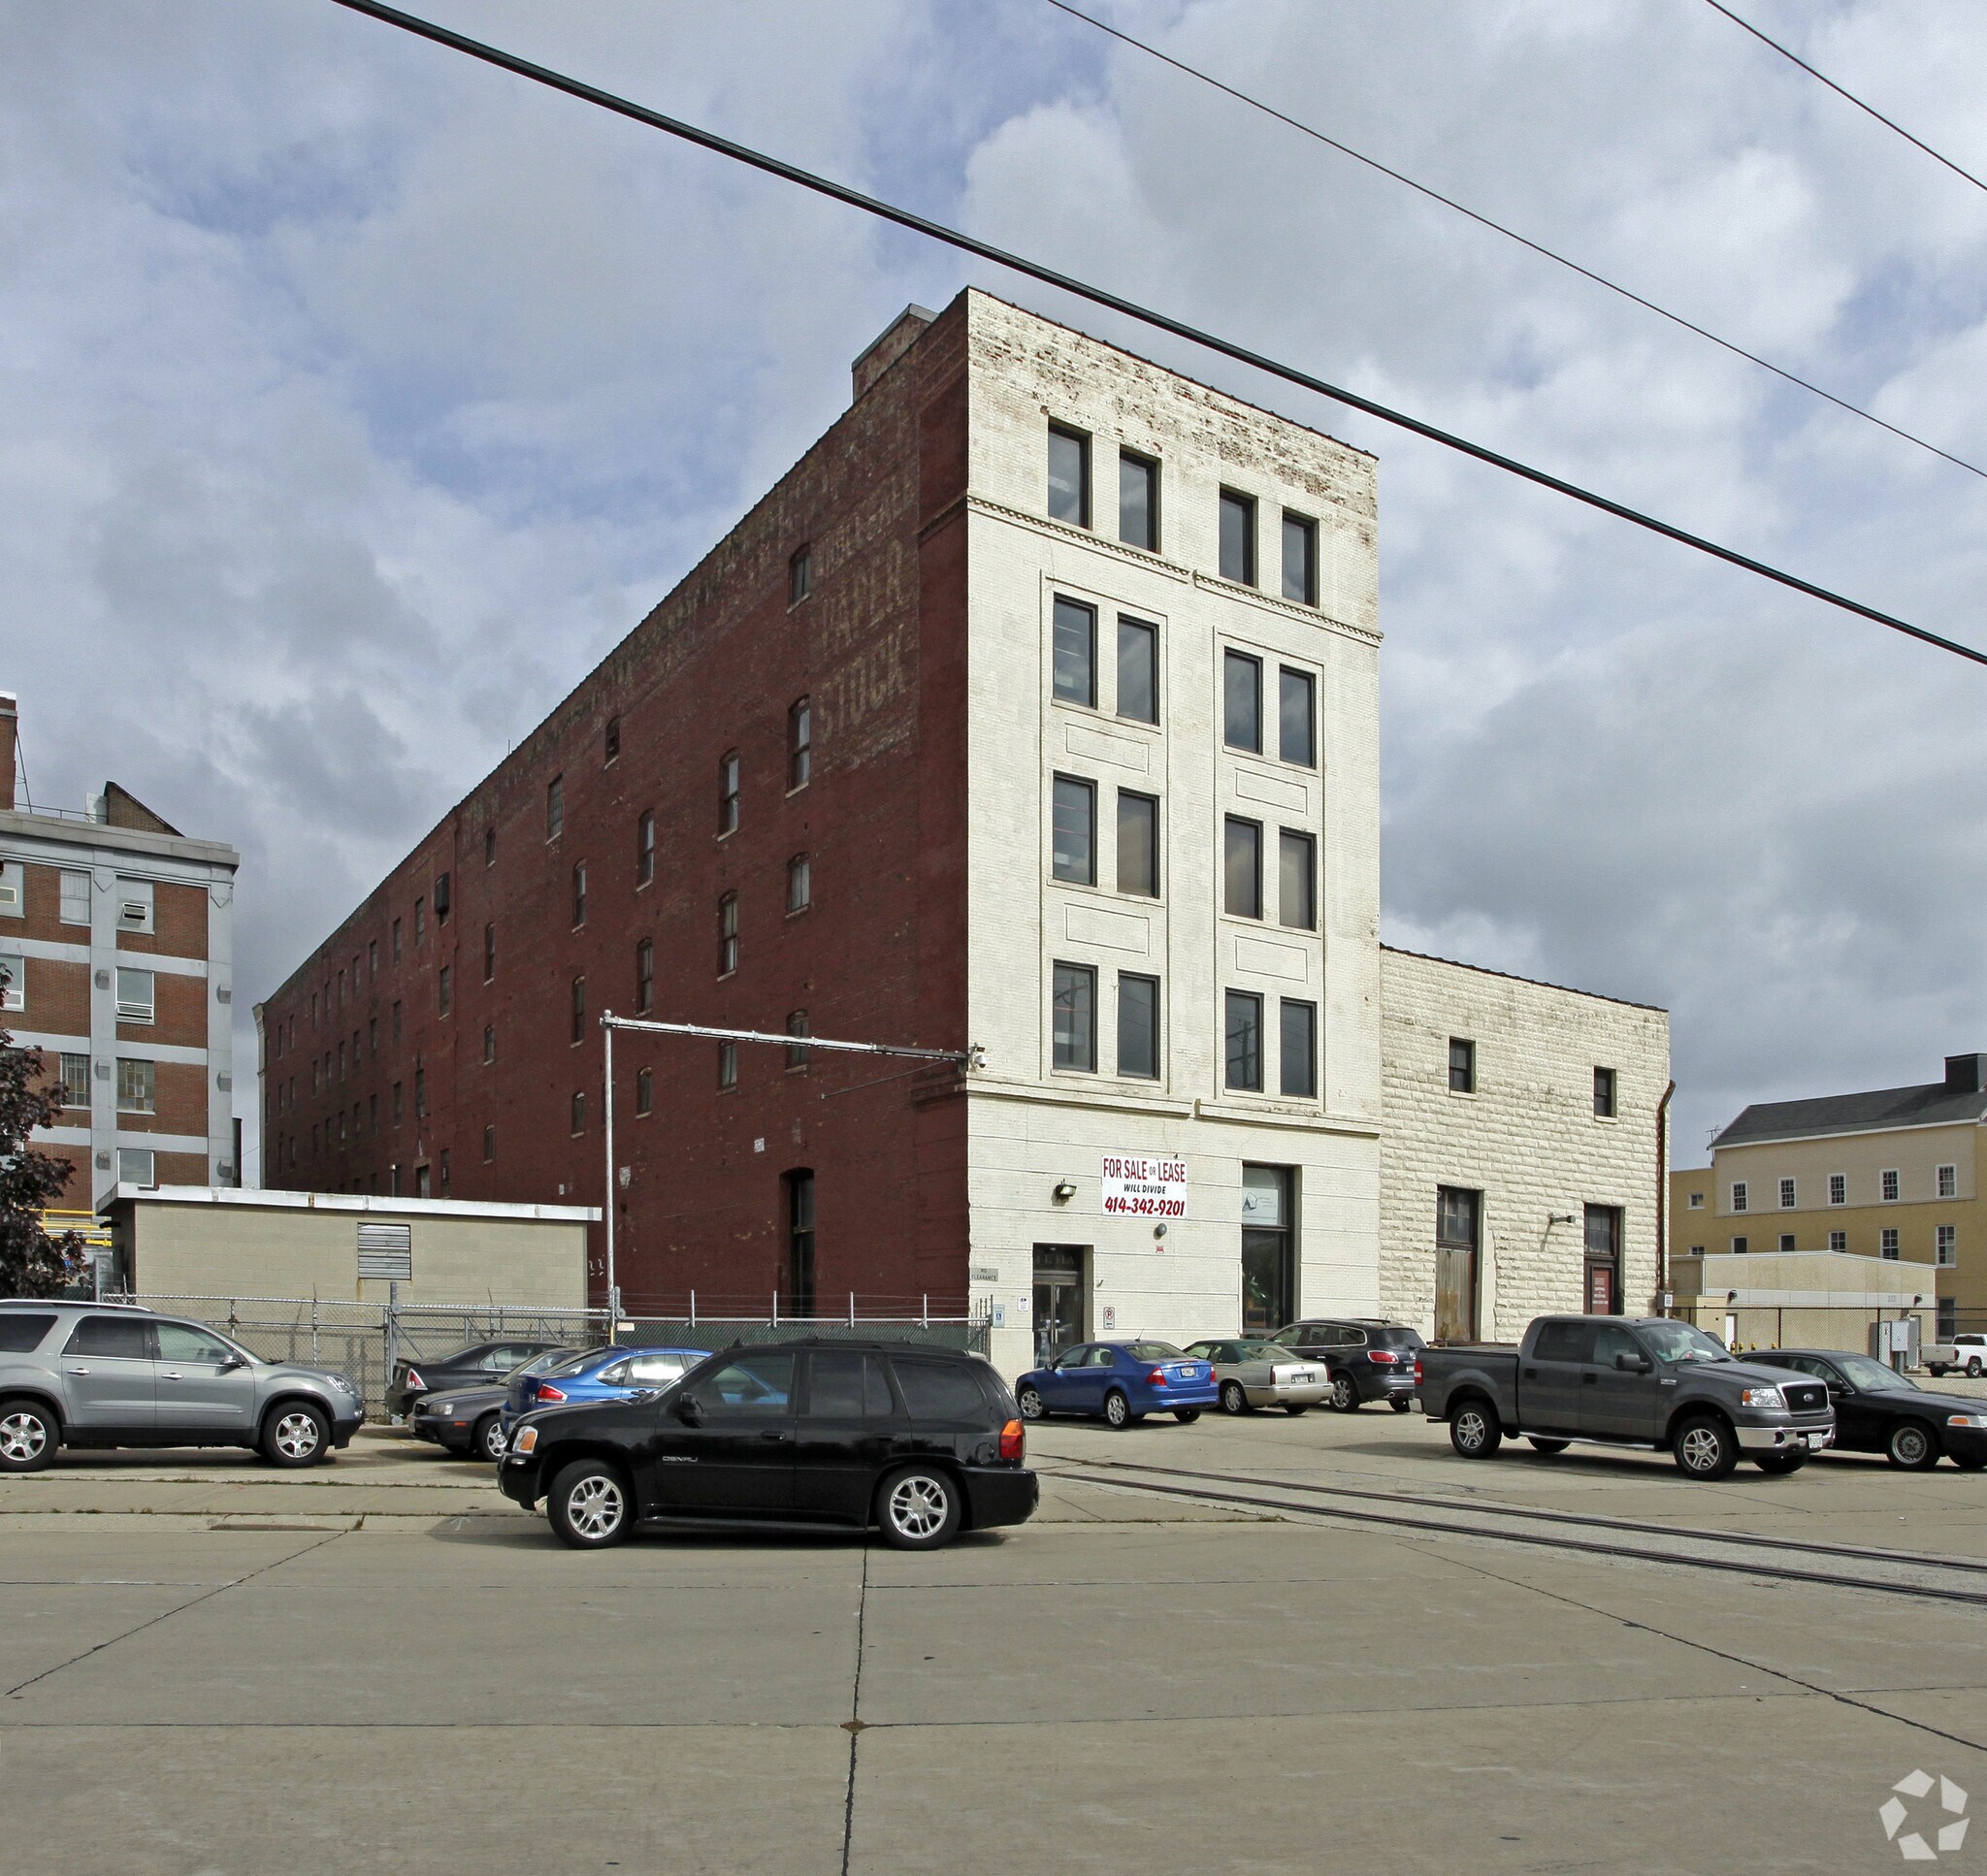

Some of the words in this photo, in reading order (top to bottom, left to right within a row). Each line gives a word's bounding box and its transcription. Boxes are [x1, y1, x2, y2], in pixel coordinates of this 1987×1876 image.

[818, 622, 905, 745] STOCK
[1103, 1158, 1122, 1179] FOR
[1124, 1159, 1147, 1180] SALE
[1149, 1166, 1156, 1176] OR
[1157, 1162, 1186, 1182] LEASE
[1124, 1183, 1140, 1193] WILL
[1142, 1184, 1166, 1194] DIVIDE
[1104, 1196, 1186, 1216] 414-342-9201
